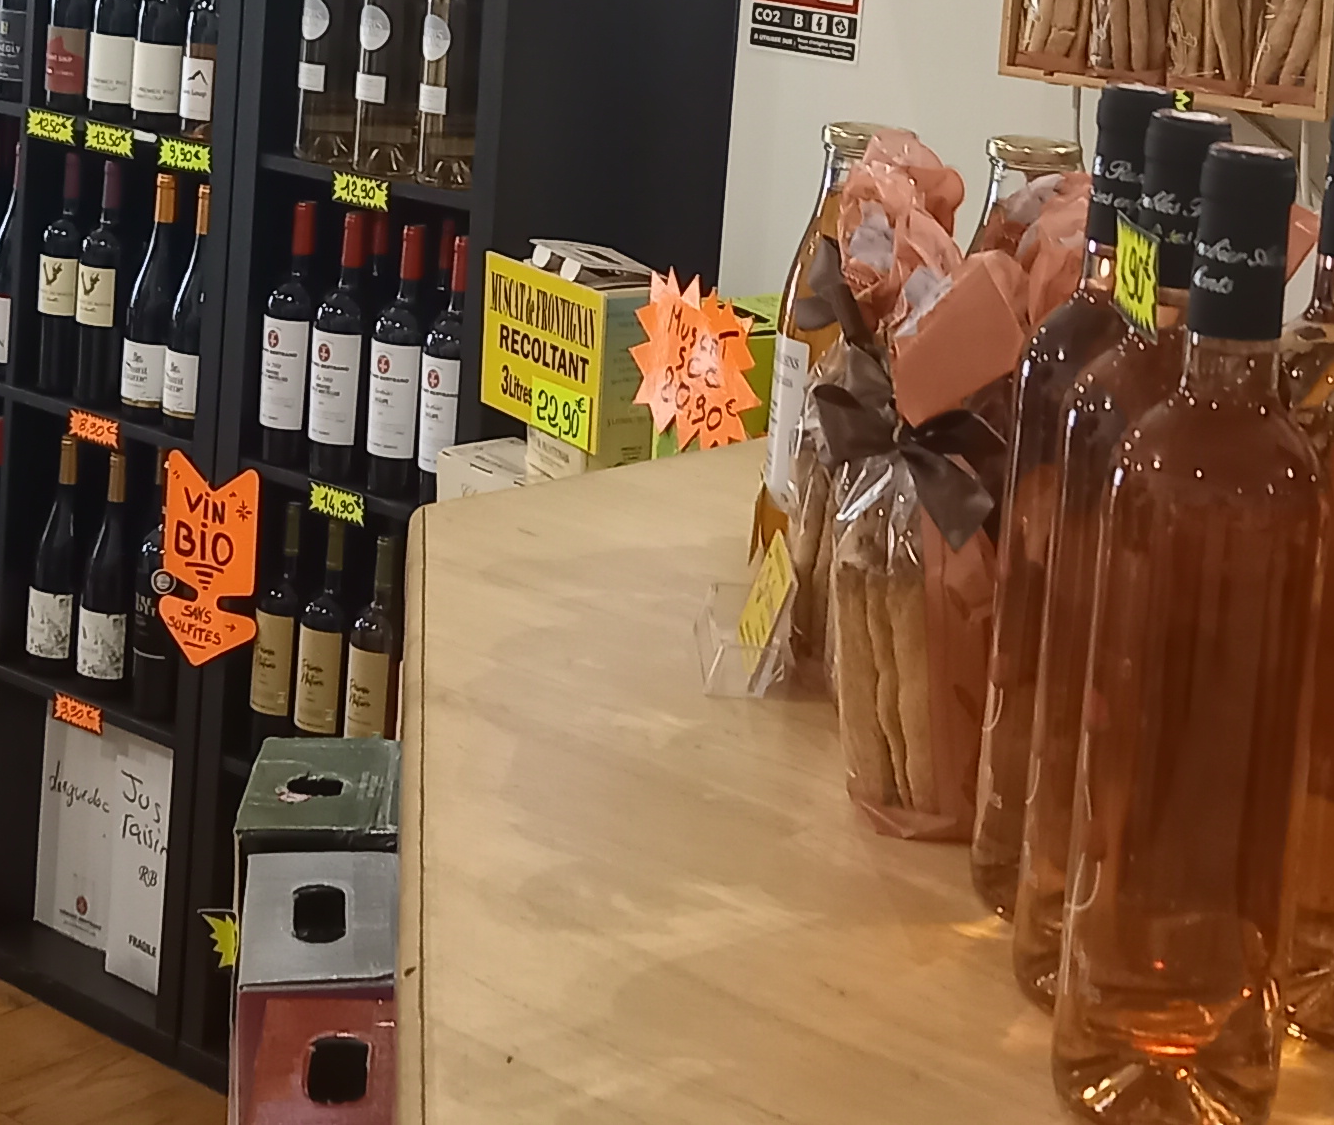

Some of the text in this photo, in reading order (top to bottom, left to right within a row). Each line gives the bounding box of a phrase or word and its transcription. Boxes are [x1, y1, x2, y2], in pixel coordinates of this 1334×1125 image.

[754, 7, 804, 28] CO2 B
[169, 143, 202, 162] 9,90€
[489, 270, 526, 325] MUSCAT
[534, 291, 598, 350] FRONTIGNAN
[498, 323, 589, 384] RECOLTANT
[535, 389, 587, 438] 22,90€
[128, 933, 157, 958] FRAGILE
